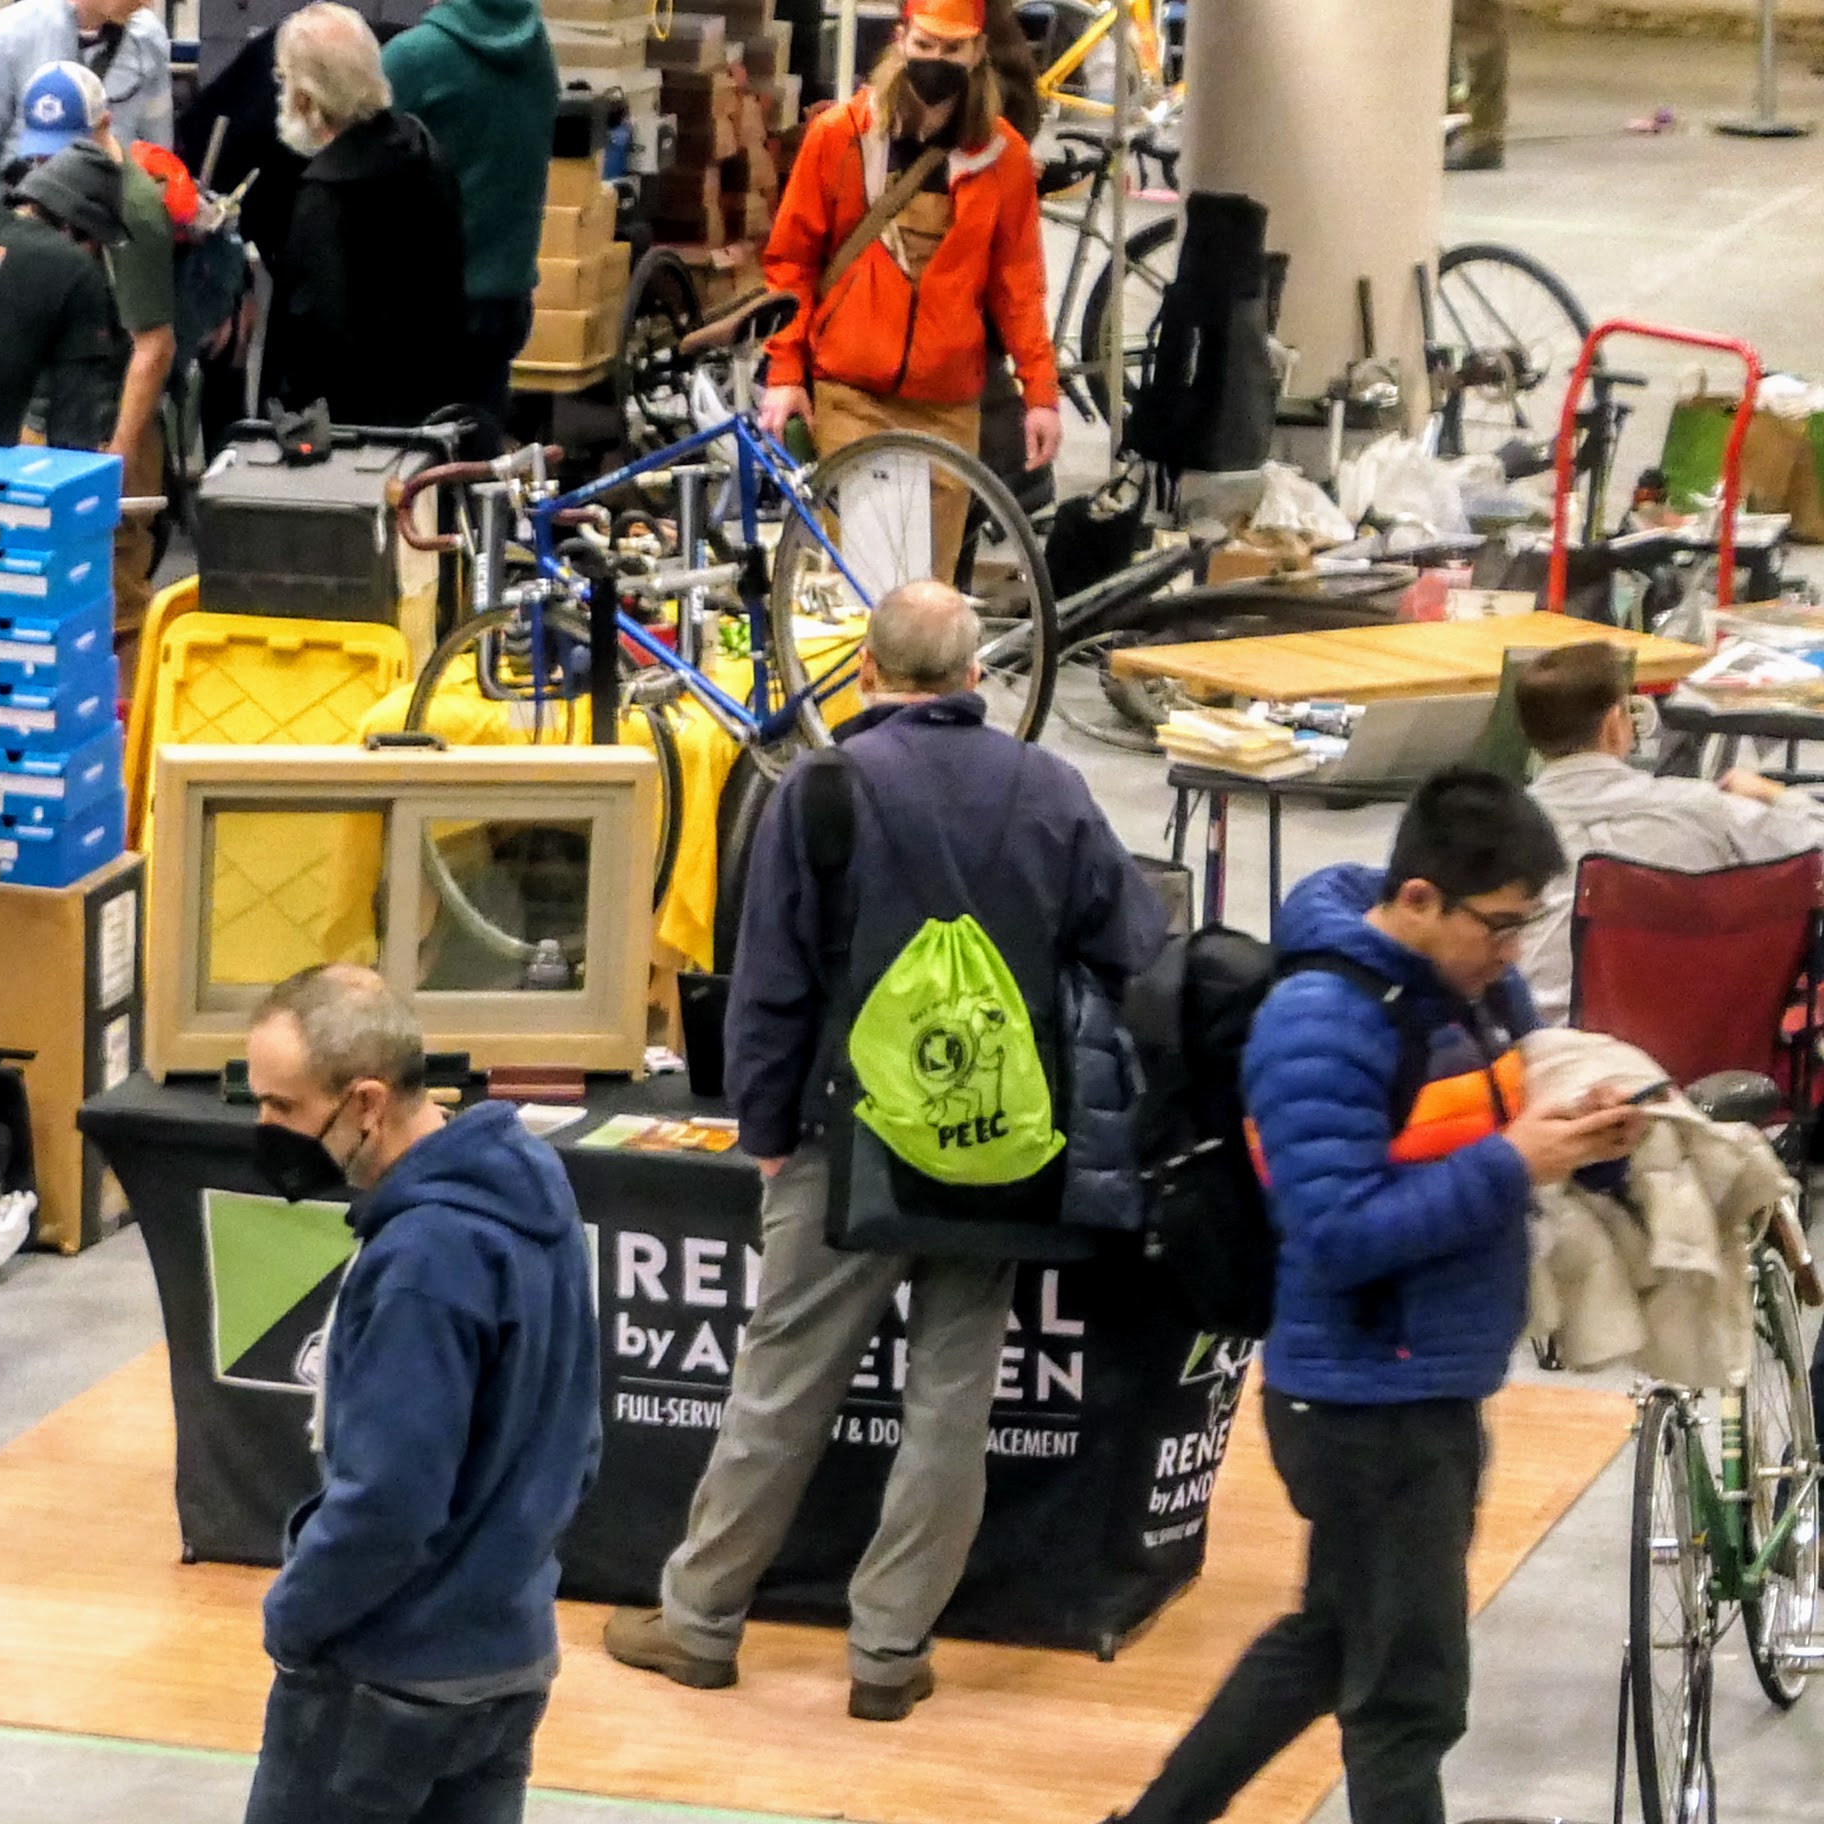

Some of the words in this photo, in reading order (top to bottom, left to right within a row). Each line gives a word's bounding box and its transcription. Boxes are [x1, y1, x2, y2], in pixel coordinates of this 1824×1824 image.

[938, 1110, 1010, 1151] PEEC
[614, 1312, 676, 1369] by
[1155, 1418, 1231, 1480] RENE
[1149, 1485, 1172, 1516] by
